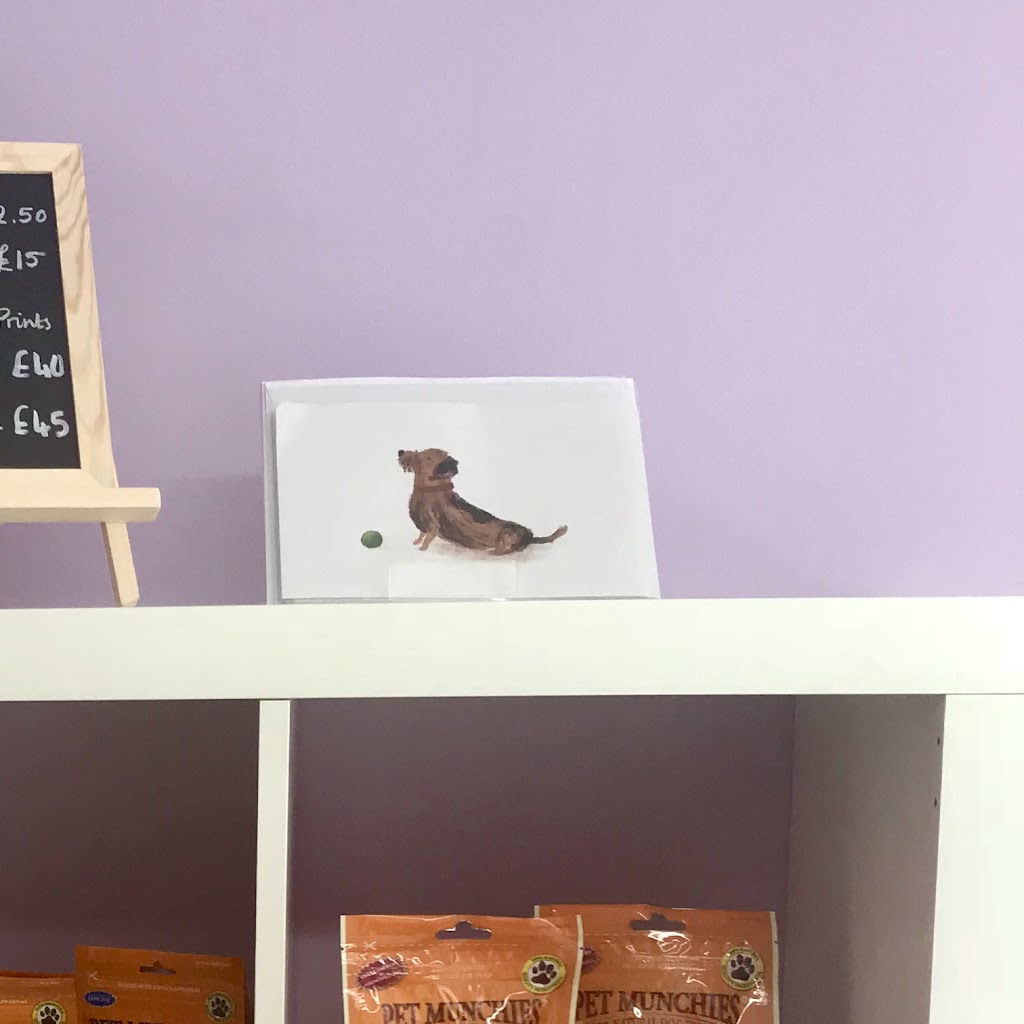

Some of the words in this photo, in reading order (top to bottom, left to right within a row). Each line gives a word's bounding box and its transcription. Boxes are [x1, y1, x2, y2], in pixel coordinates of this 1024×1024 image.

[12, 349, 66, 380] £40
[13, 404, 71, 438] £45
[576, 990, 612, 1022] PET
